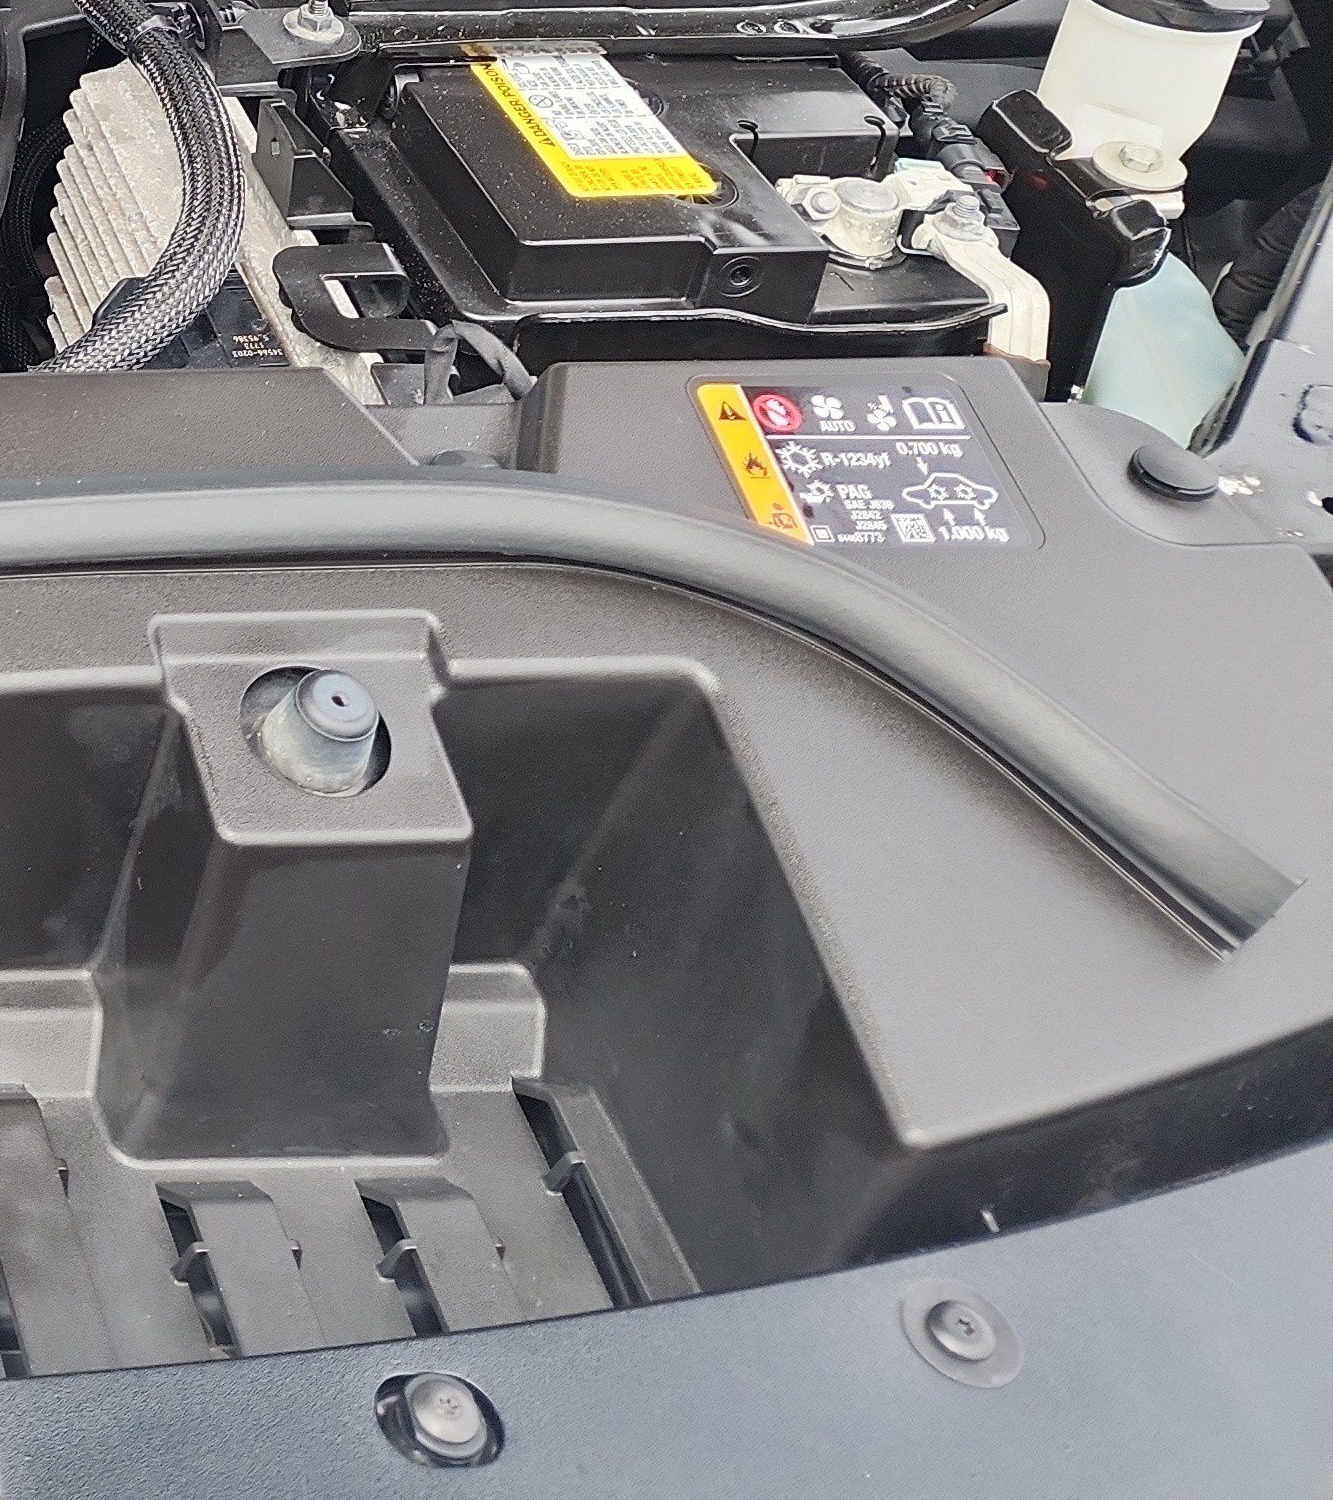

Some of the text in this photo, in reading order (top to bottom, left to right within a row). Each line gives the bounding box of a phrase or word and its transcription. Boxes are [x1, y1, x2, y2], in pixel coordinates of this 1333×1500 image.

[480, 63, 548, 137] DANGER POISON
[819, 419, 856, 432] AUTO
[895, 441, 963, 458] 0.700 kg
[819, 451, 891, 469] R-1234yf
[835, 483, 873, 499] PAG
[843, 499, 868, 510] SAE
[938, 525, 1011, 543] 1.000 kg
